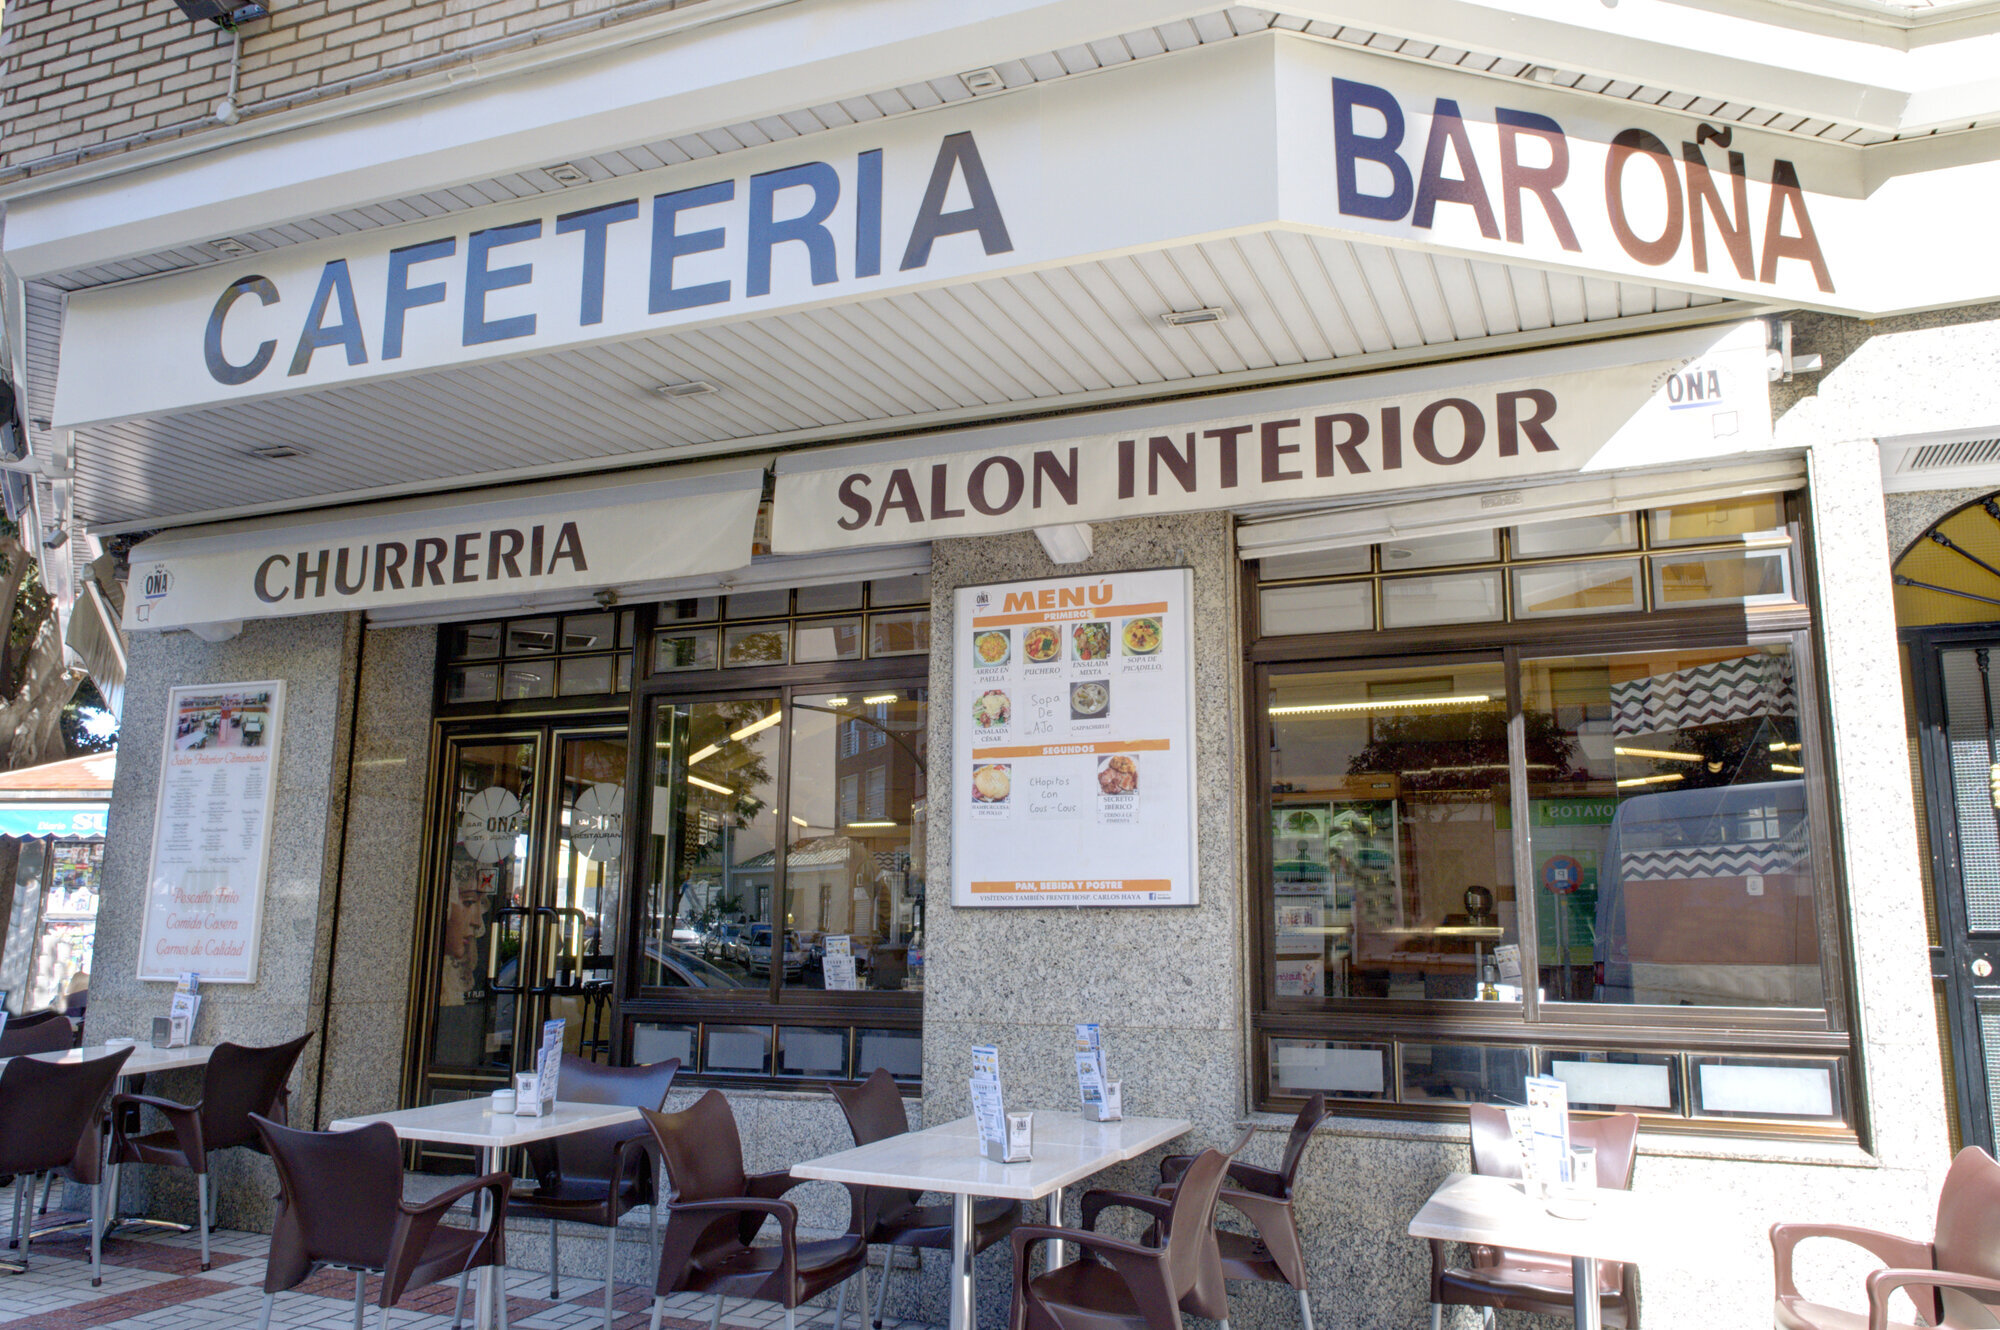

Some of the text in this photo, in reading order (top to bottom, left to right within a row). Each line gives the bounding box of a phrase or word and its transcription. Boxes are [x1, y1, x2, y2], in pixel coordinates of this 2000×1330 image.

[1331, 76, 1836, 294] BAR OÑA
[203, 129, 1014, 386] CAFETERIA
[836, 387, 1560, 531] SALON INTERIOR
[253, 521, 589, 604] CHURRERIA
[145, 570, 168, 595] OÑA
[1003, 579, 1113, 613] MENÚ
[1043, 609, 1093, 621] PRIMEROS
[1072, 660, 1109, 668] ENSALADA
[1127, 656, 1147, 664] SOPA
[976, 667, 999, 675] ARROZ
[1024, 666, 1061, 676] PUCHERO
[1079, 668, 1102, 676] MIXTA
[1031, 694, 1060, 707] Sopa
[1038, 707, 1054, 718] De
[974, 728, 1009, 736] ENSALADA
[1042, 744, 1095, 755] SEGUNDOS
[1103, 795, 1134, 803] SECRETO
[36, 821, 66, 831] Diario
[1015, 880, 1123, 892] PAN, BEBIDA Y POSTRE
[1046, 893, 1071, 901] FRENTE
[166, 912, 239, 930] Comida Casera
[156, 938, 246, 957] Carnes de Calidad
